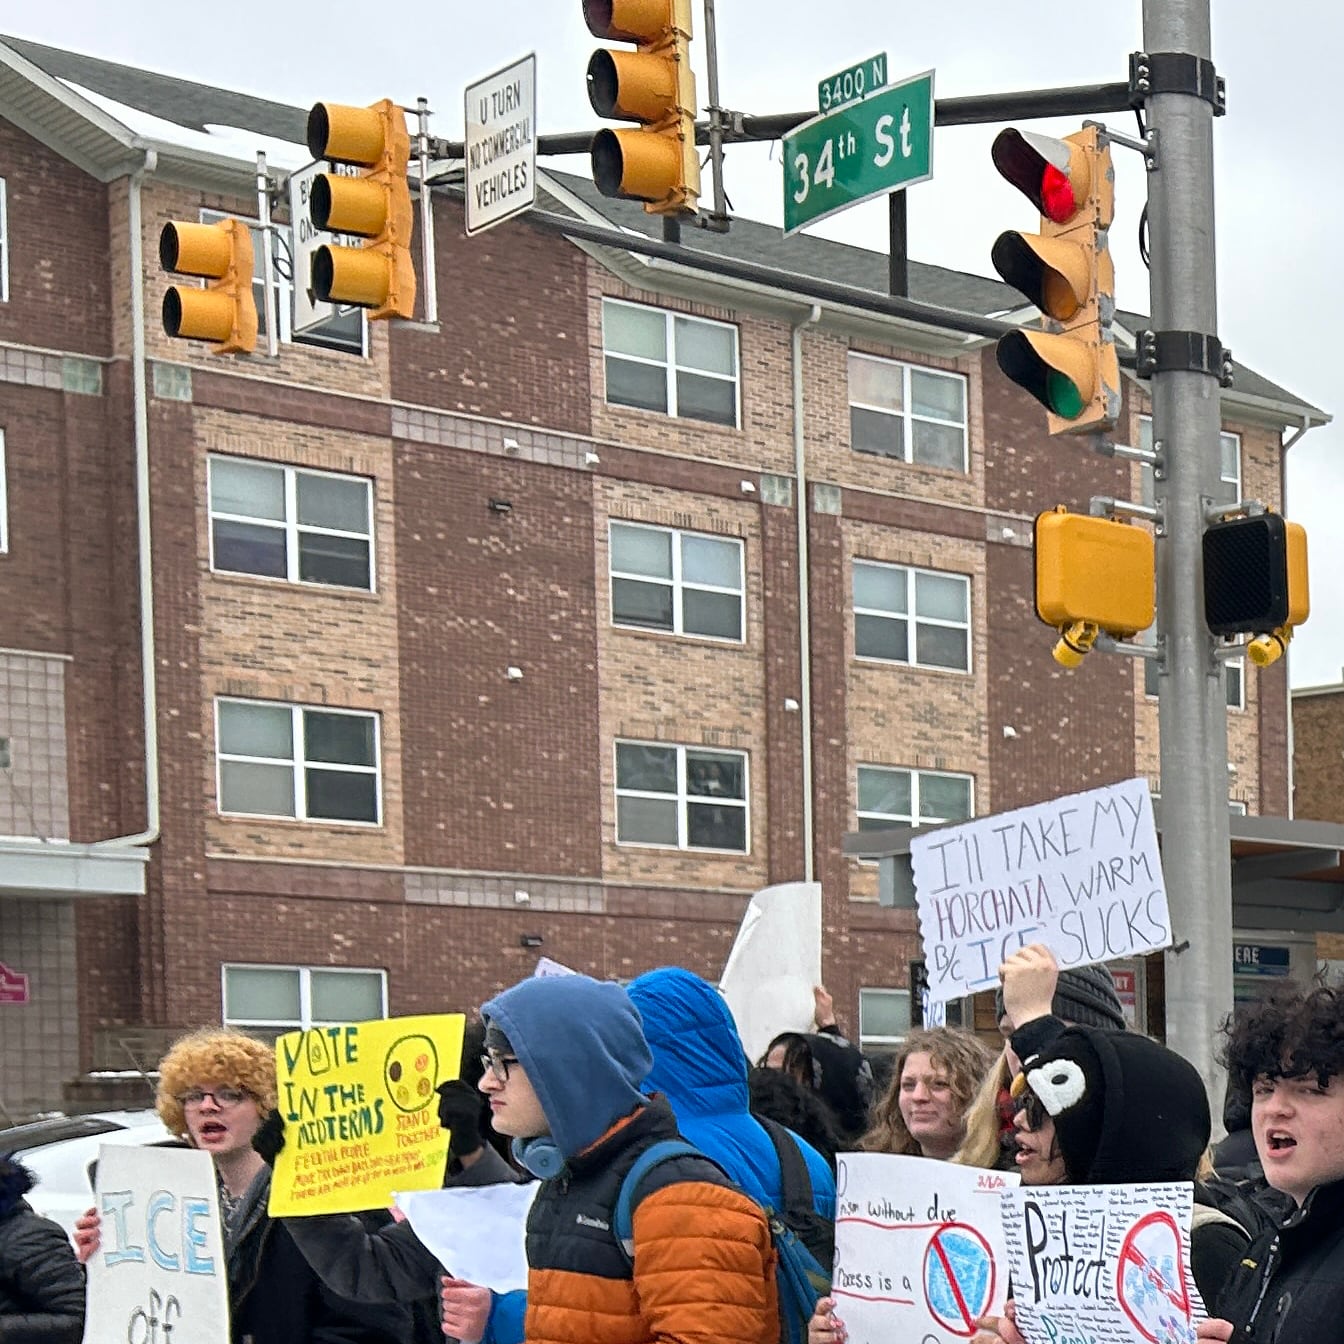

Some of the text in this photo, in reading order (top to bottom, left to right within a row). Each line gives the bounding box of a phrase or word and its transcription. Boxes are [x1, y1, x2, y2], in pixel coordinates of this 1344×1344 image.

[479, 79, 522, 125] U TURN
[822, 57, 884, 110] 3400 N
[482, 116, 532, 166] COMMERCIAL
[793, 106, 913, 204] 34th St
[474, 160, 529, 209] VEHICLES
[992, 808, 1081, 872] TAKE
[1089, 793, 1144, 850] MY
[1060, 851, 1154, 906] WARM
[1059, 888, 1168, 966] SUCKS
[282, 1026, 359, 1077] VOTE
[284, 1082, 365, 1122] IN THE
[298, 1097, 385, 1150] MIDTERMS
[101, 1188, 217, 1277] ICE
[867, 1196, 917, 1223] without
[926, 1192, 957, 1222] due
[1024, 1200, 1106, 1305] Protect
[878, 1271, 893, 1291] is
[902, 1275, 913, 1292] a
